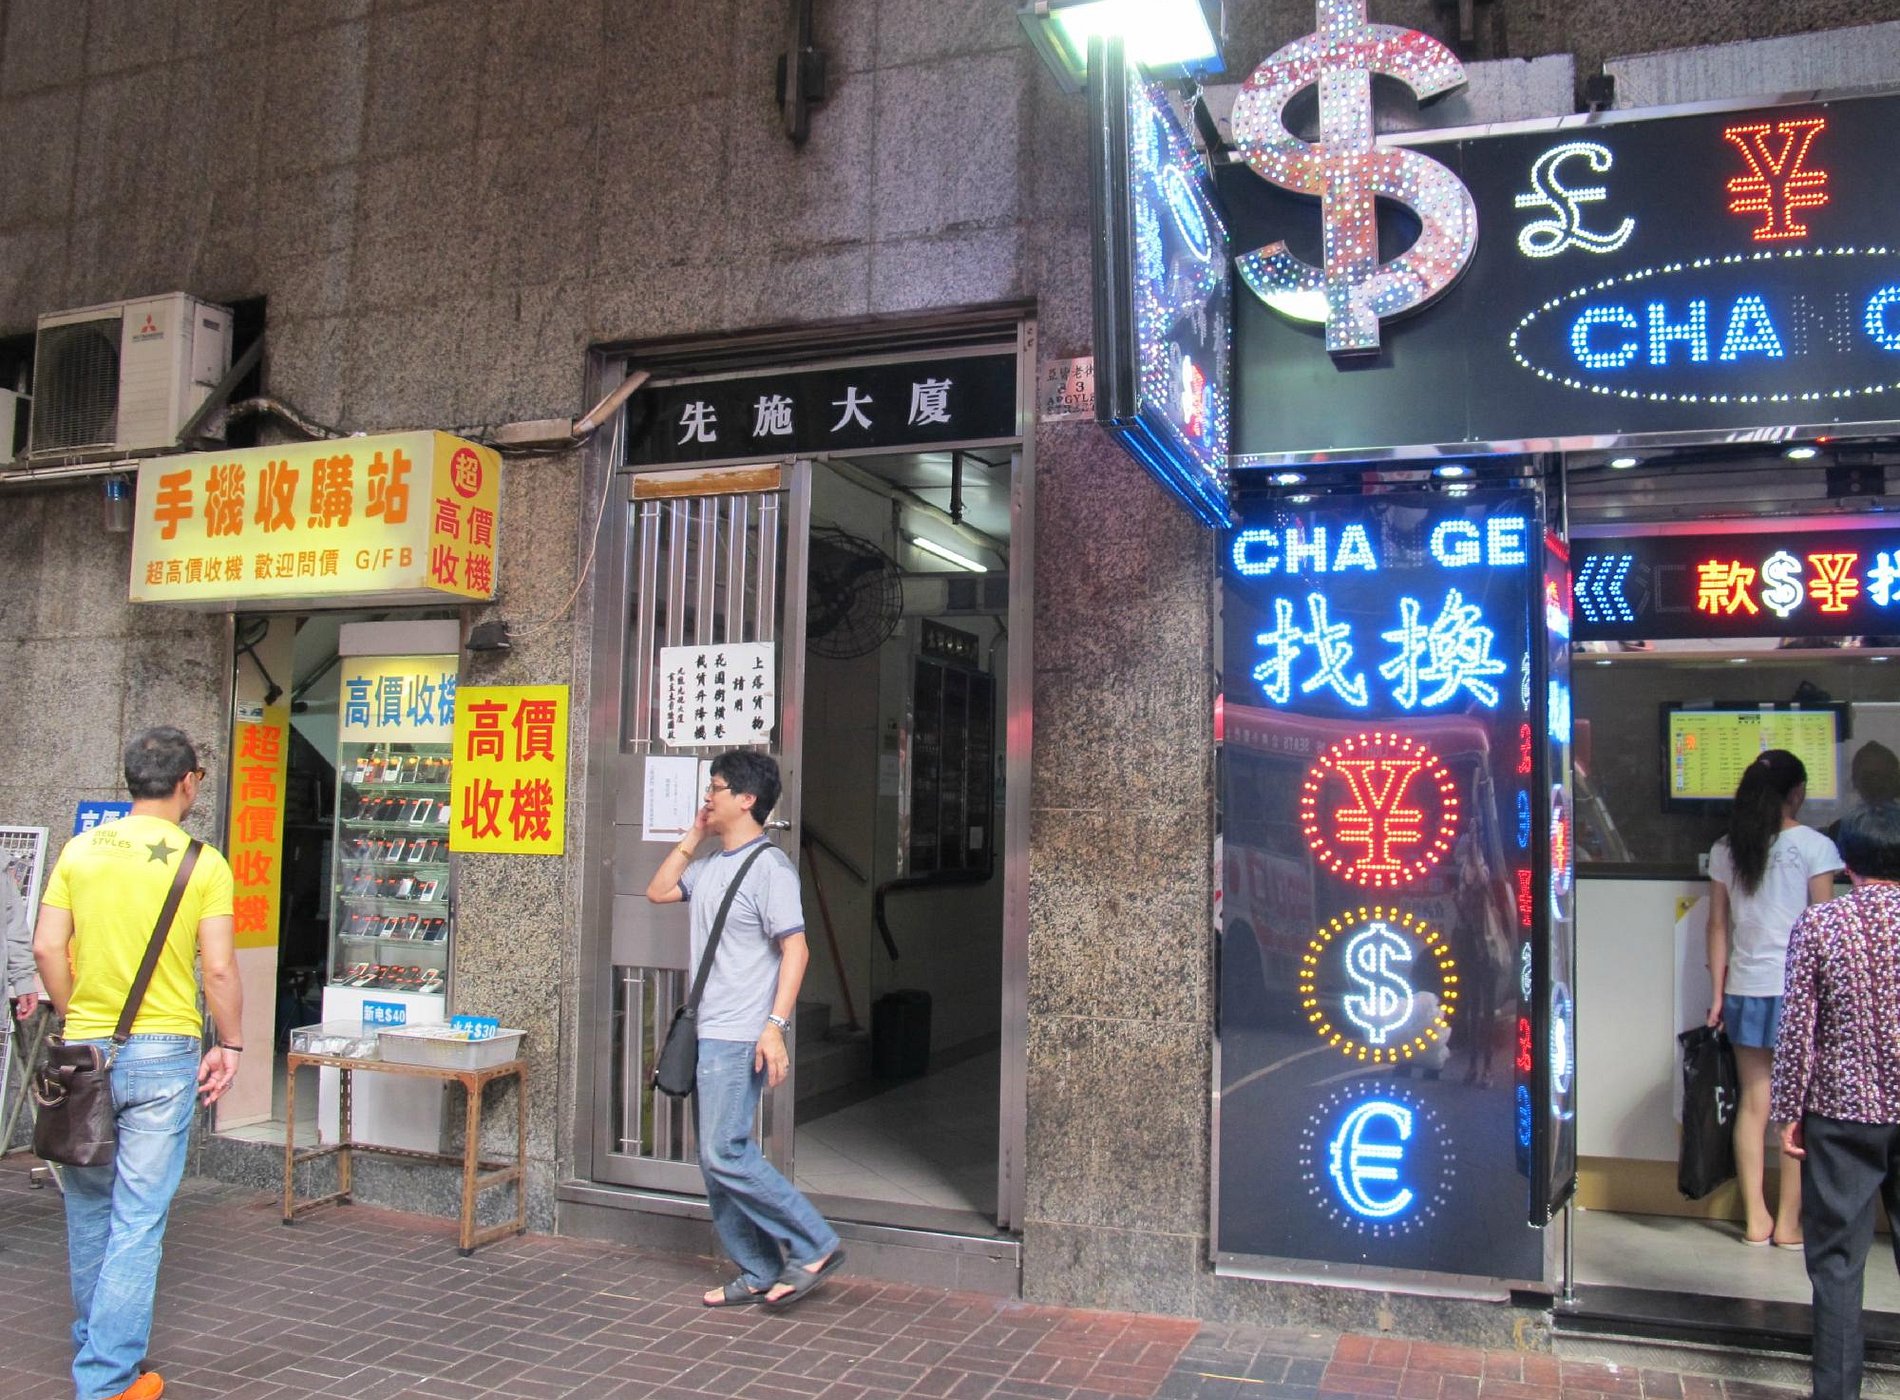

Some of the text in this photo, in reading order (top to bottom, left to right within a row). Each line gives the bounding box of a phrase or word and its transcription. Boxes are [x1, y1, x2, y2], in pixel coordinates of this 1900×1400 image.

[678, 378, 953, 445] 先施大廈
[154, 448, 412, 540] 手機收購站
[455, 453, 478, 492] 超
[435, 497, 493, 549] 高價
[145, 555, 243, 585] 超高價收機
[254, 549, 339, 580] 歡迎問價
[432, 544, 491, 594] 收機
[1252, 587, 1507, 710] 找換
[466, 697, 557, 763] 高價
[233, 724, 282, 934] 超高價收機
[461, 778, 553, 841] 收機
